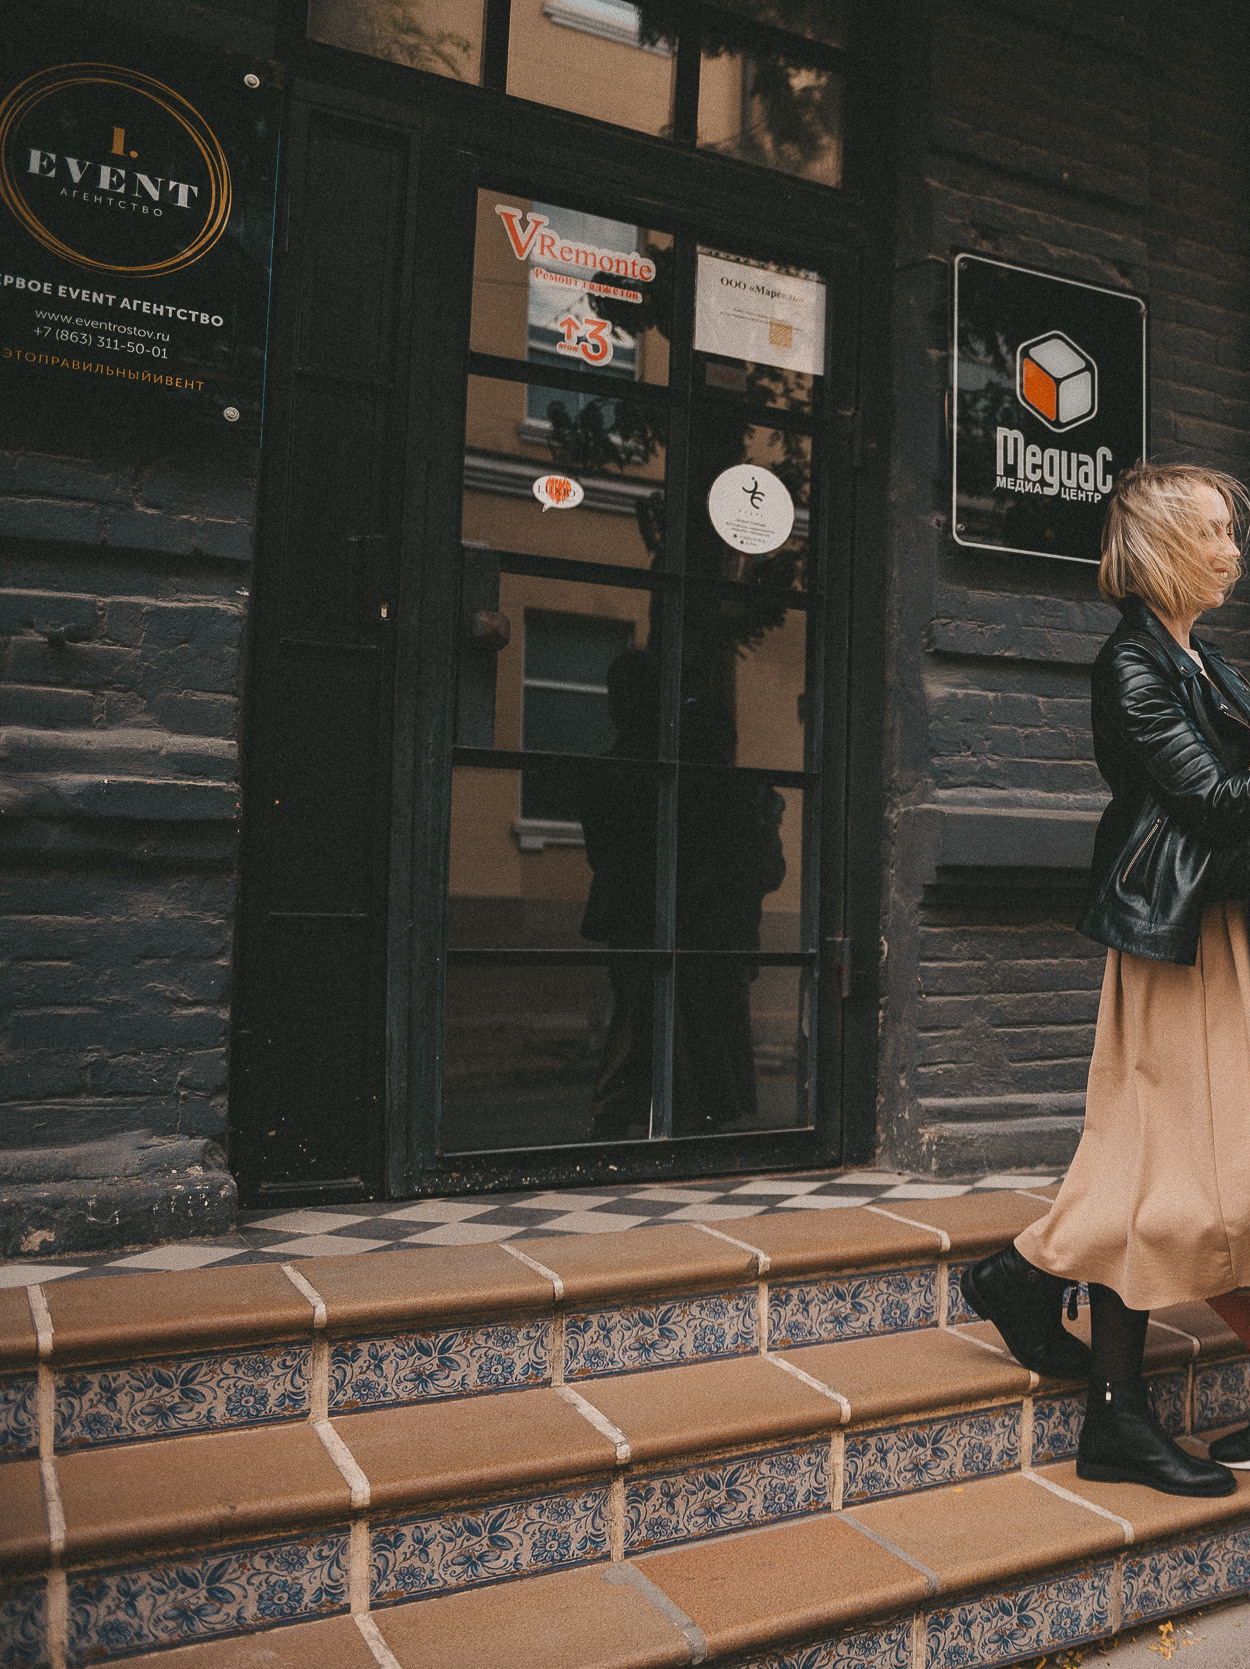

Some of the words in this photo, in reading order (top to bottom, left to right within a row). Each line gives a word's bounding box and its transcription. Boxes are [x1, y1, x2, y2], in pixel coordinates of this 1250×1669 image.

[26, 148, 199, 209] EVENT
[60, 188, 163, 217] АГЕНТСТВО
[0, 273, 52, 295] РВОЕ
[58, 285, 116, 307] EVENT
[120, 298, 224, 327] АГЕНТСТВО
[720, 277, 747, 290] ООО
[35, 308, 170, 342] www.eventrostov.ru
[581, 318, 607, 361] 3
[33, 326, 51, 338] +7
[55, 327, 93, 348] (863)
[96, 336, 168, 359] 311-50-01
[2, 347, 205, 391] ЭТОПРАВИЛЬНЫЙИВЕНТ
[996, 476, 1043, 494] МЕДИА
[1061, 488, 1102, 503] ЦЕНТР
